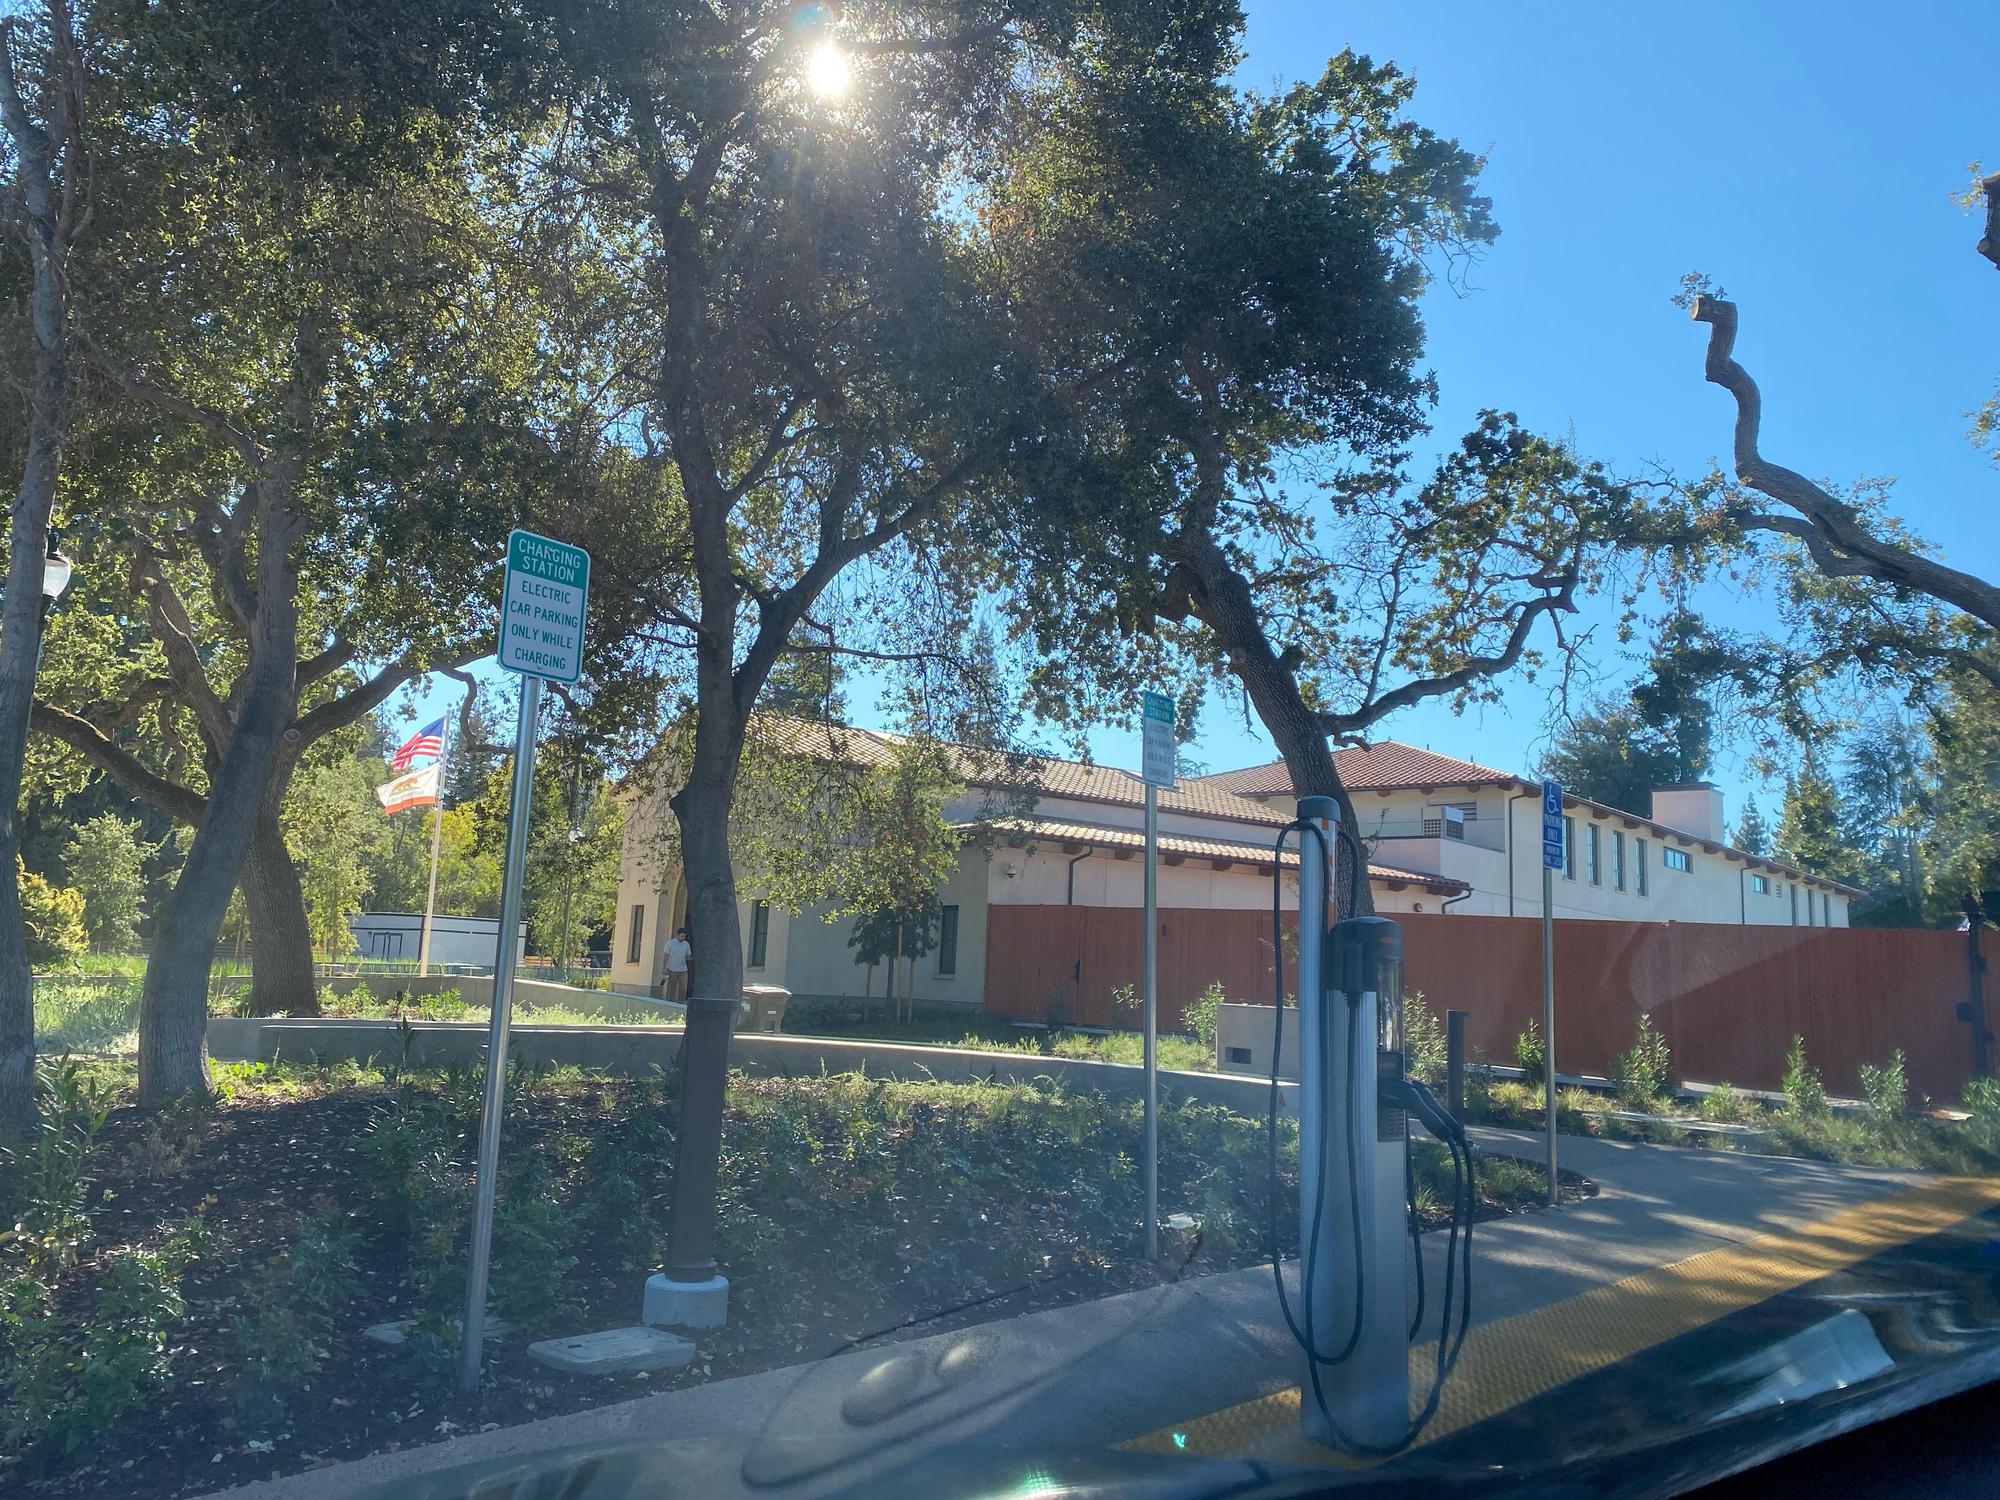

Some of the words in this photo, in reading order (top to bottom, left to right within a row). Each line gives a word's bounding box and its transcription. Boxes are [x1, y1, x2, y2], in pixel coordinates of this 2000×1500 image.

[519, 538, 581, 569] CHARGING
[522, 555, 575, 583] STATION
[522, 580, 571, 604] ELECTRIC
[510, 600, 531, 617] CAR
[534, 606, 578, 628] PARKING
[511, 623, 539, 641] ONLY
[542, 630, 573, 650] WHILE
[515, 647, 566, 670] CHARGING
